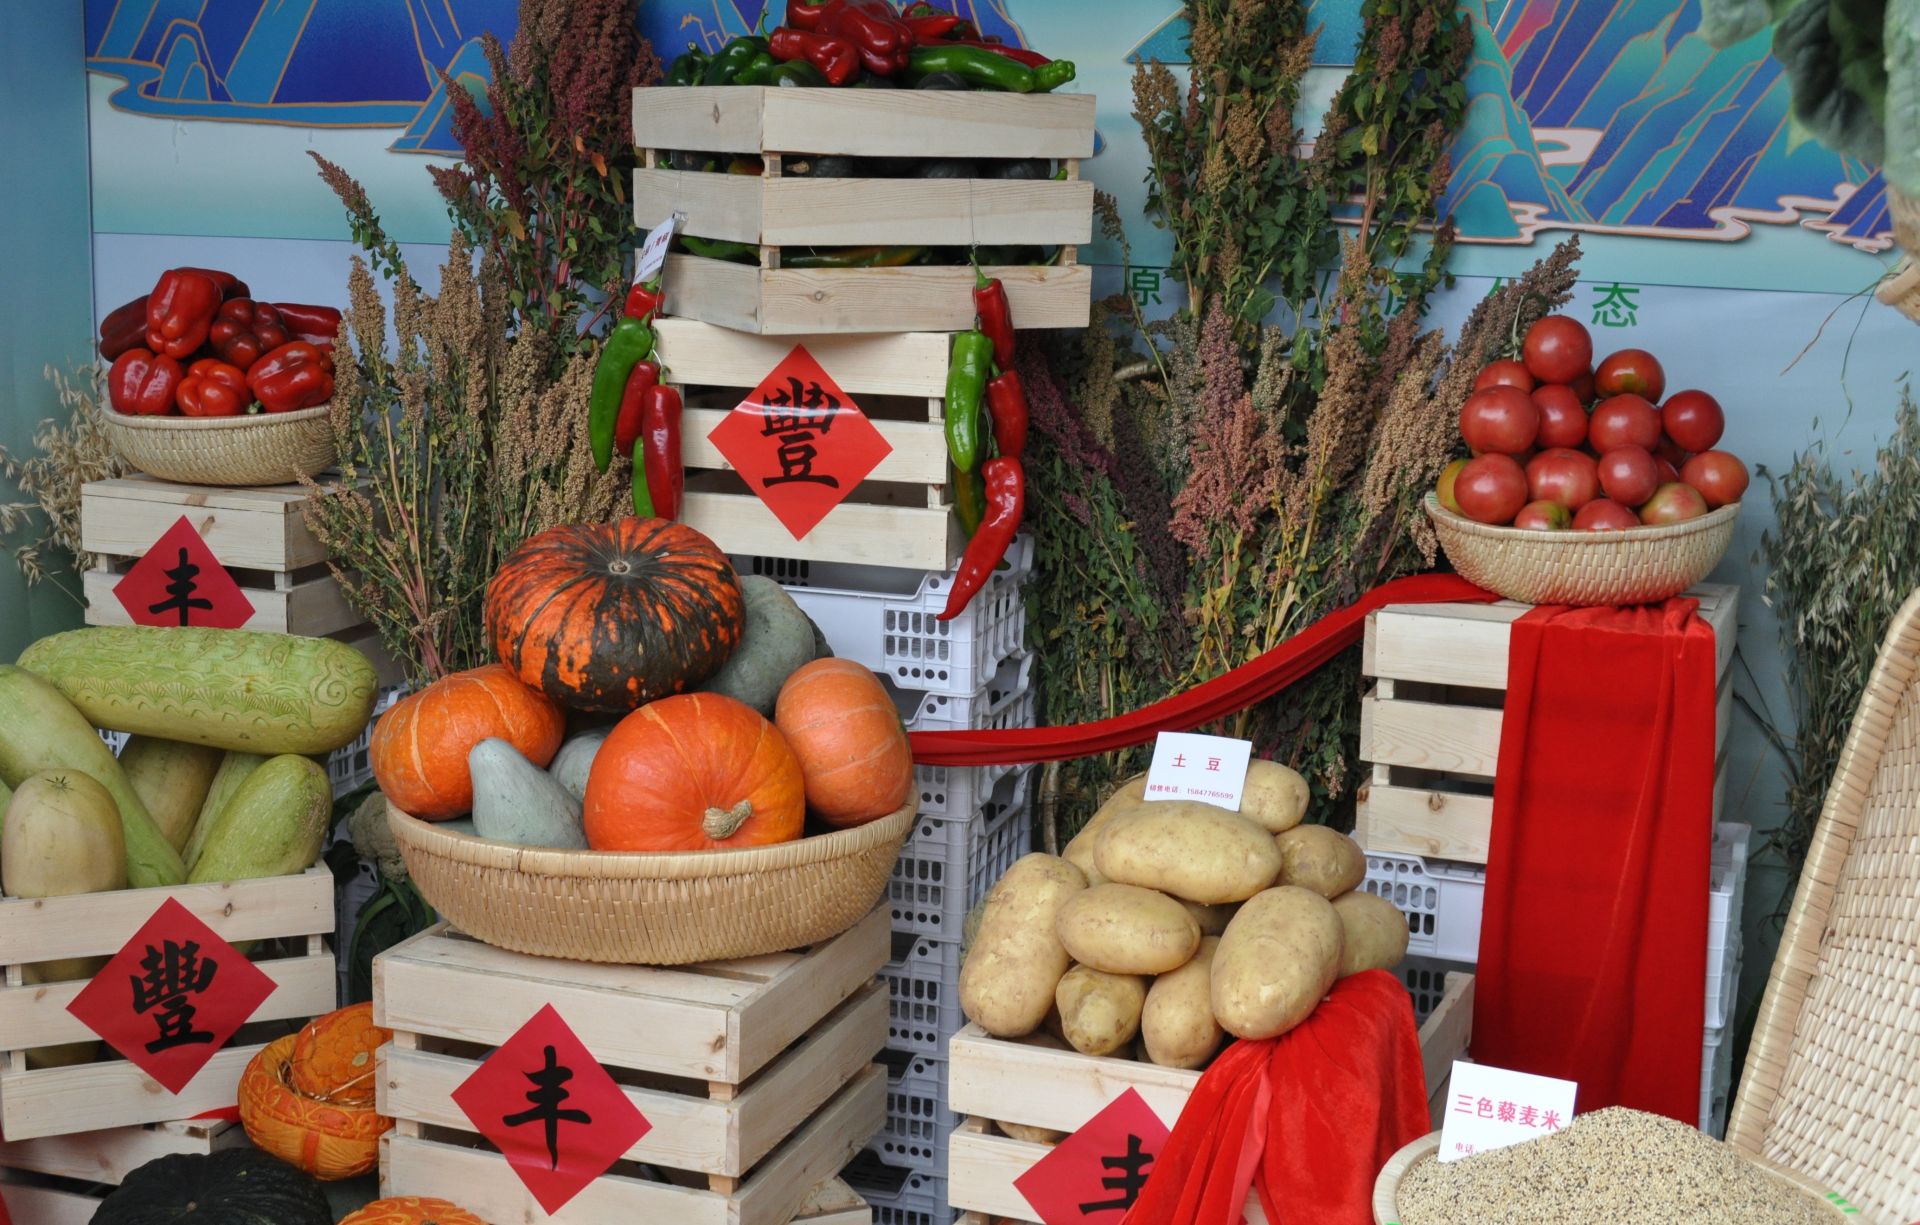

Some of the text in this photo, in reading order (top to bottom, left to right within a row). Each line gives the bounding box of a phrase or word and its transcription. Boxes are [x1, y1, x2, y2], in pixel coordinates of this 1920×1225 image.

[1591, 282, 1640, 328] 态
[148, 547, 213, 626] 丰
[502, 1045, 592, 1172] 丰
[1454, 1094, 1561, 1131] 三色藜麦米
